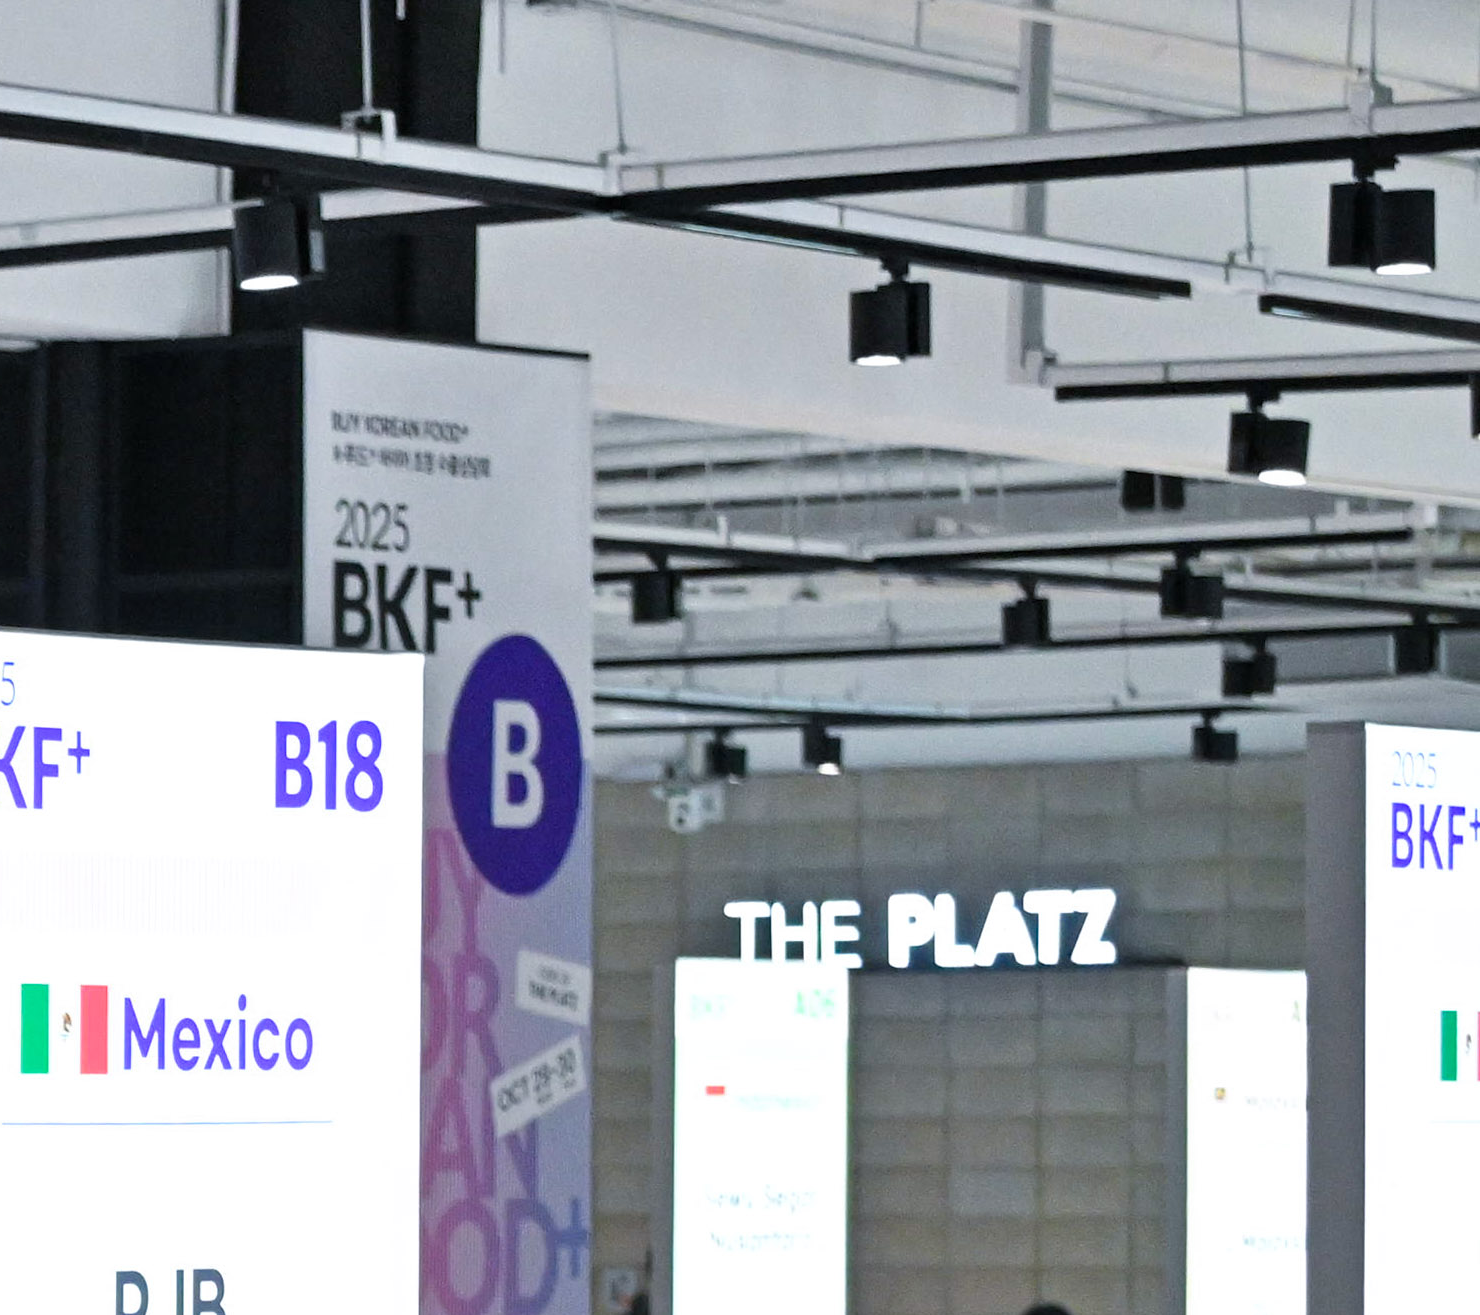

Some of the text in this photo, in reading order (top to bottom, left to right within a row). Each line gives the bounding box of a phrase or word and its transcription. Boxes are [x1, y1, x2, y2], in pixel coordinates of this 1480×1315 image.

[335, 499, 410, 551] 2025
[274, 720, 385, 812] B18
[490, 700, 545, 829] B
[1391, 750, 1438, 789] 2025
[723, 888, 1118, 969] THE PLATZ
[123, 994, 314, 1073] Mexico
